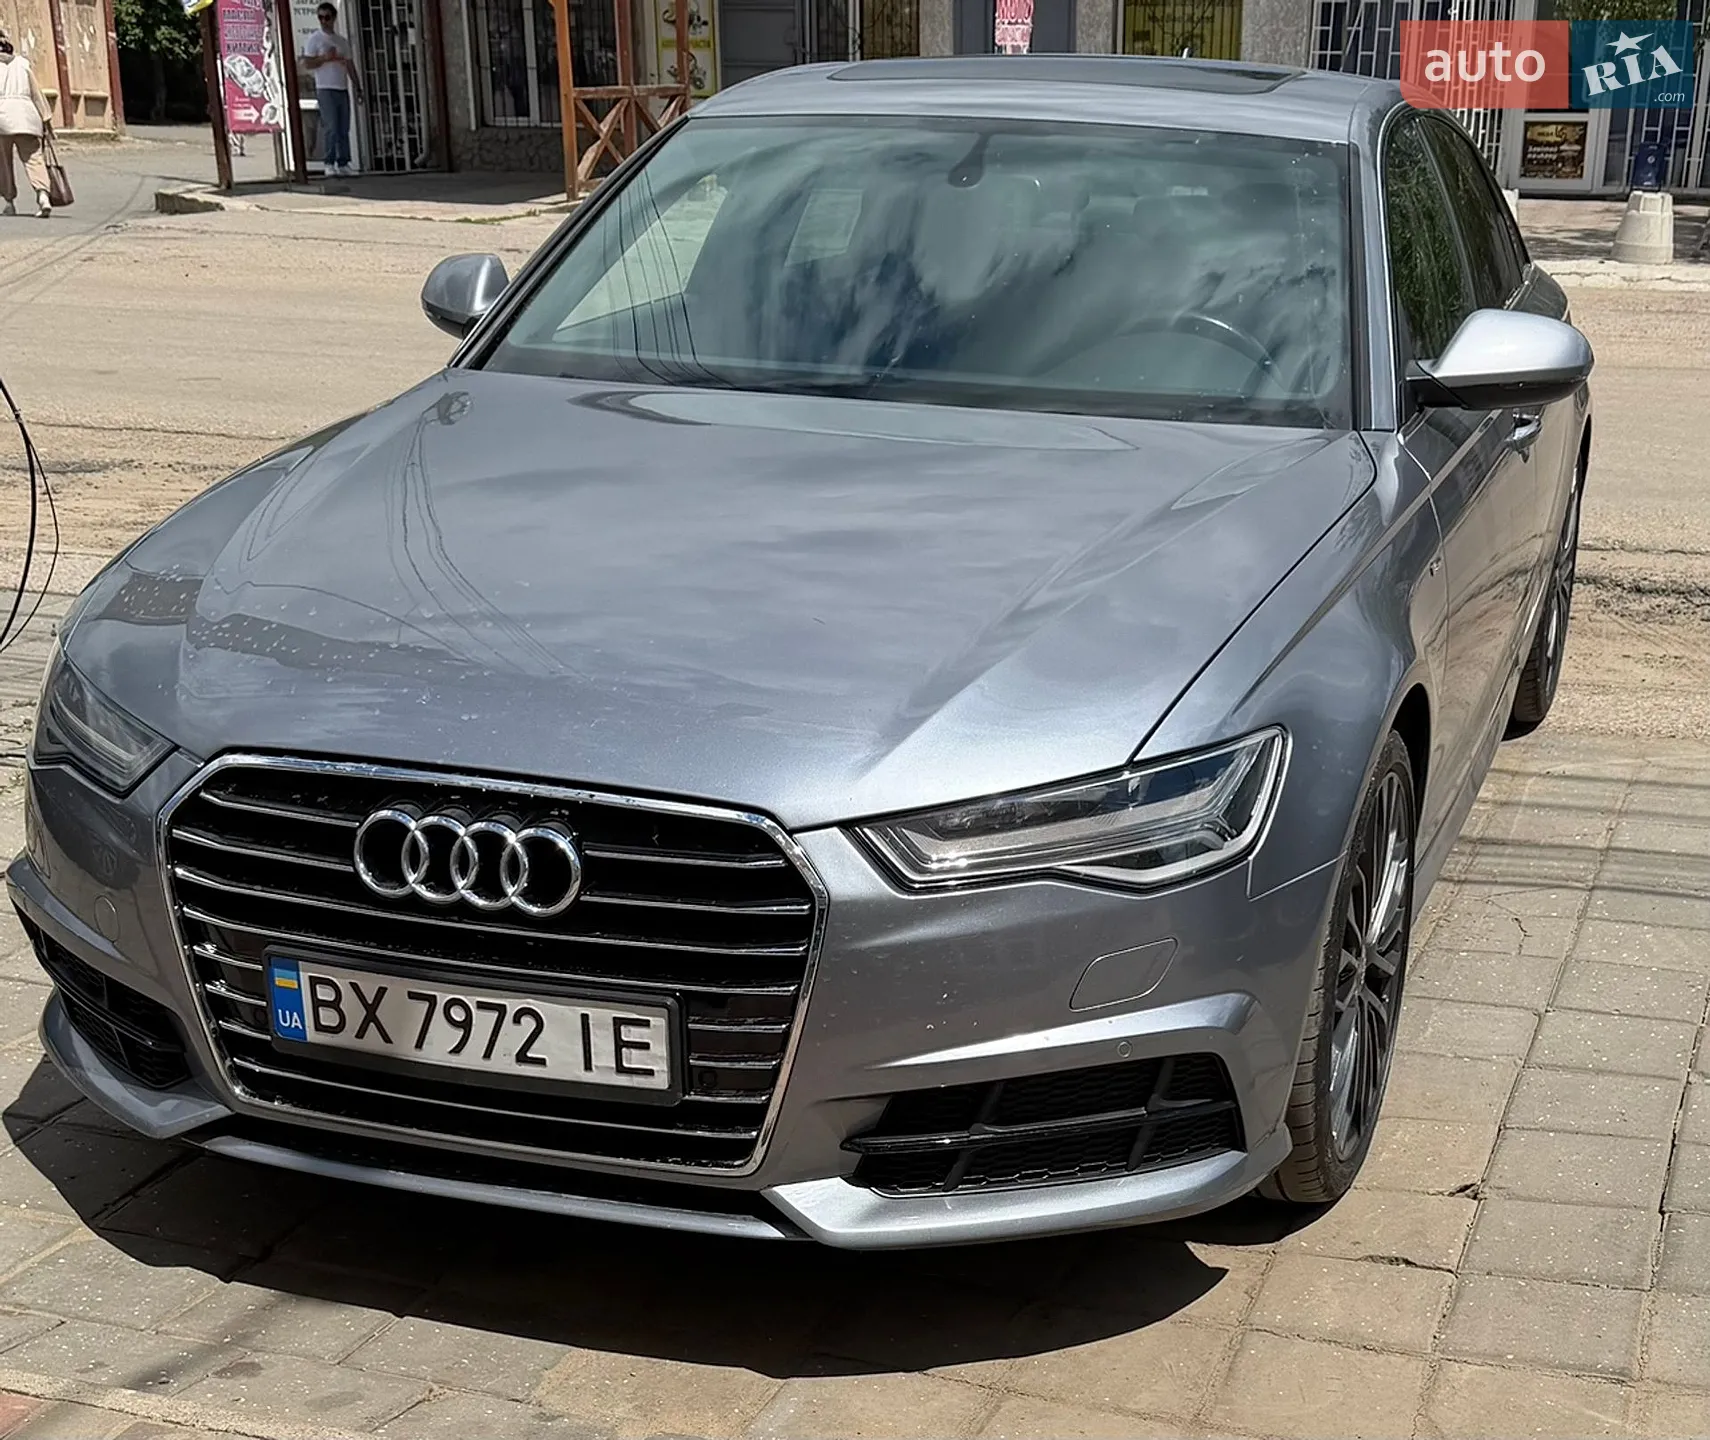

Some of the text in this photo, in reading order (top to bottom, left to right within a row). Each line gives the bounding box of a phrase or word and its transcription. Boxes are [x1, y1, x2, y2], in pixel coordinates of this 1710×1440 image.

[278, 1008, 303, 1031] UA
[307, 974, 656, 1077] BX 7972 IE
